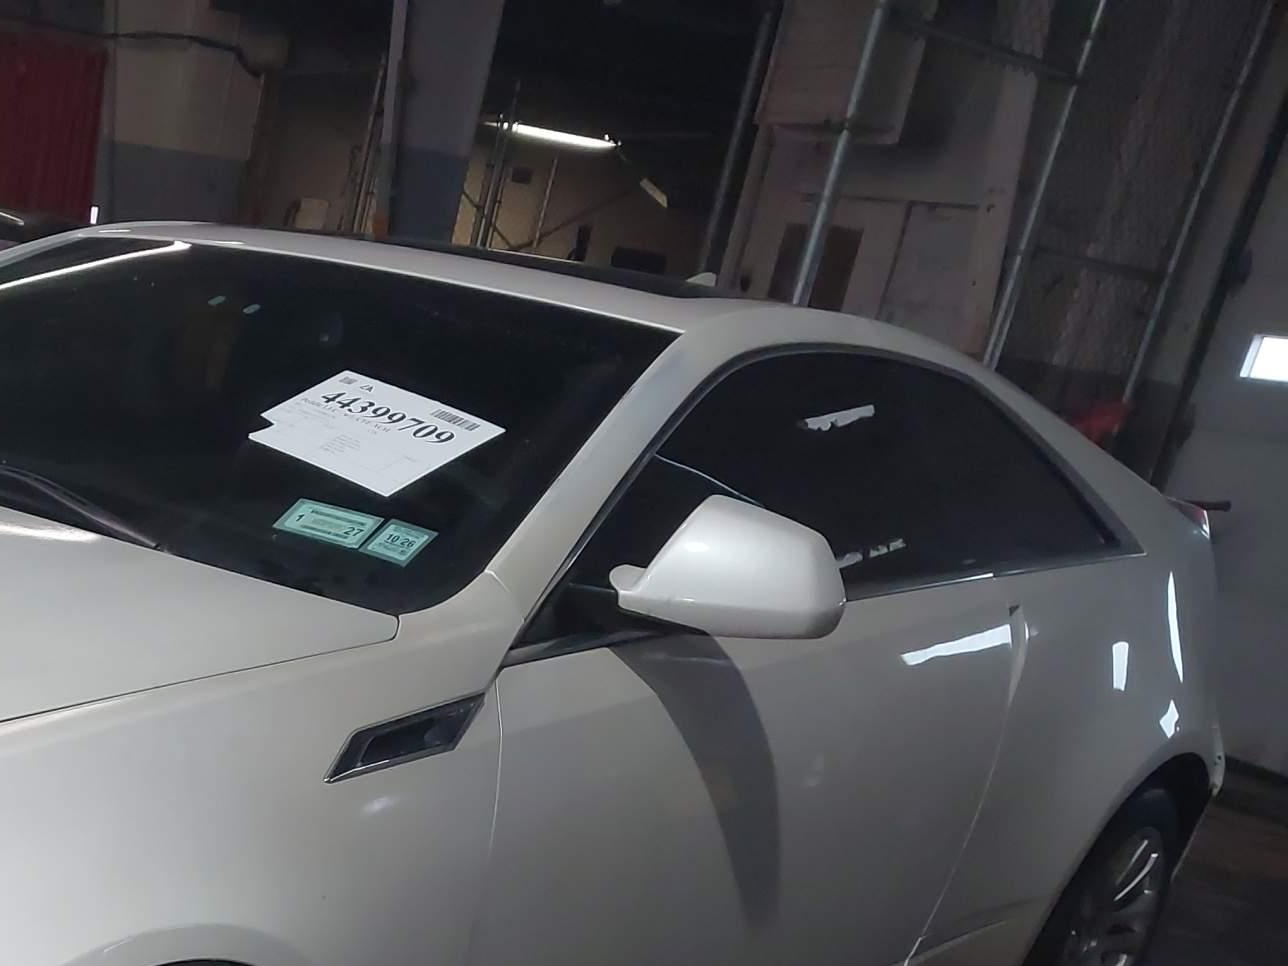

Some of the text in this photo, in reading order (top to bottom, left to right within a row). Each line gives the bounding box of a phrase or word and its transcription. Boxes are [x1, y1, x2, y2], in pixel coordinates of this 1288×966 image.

[320, 391, 456, 444] 44399709
[296, 513, 304, 521] 1
[343, 526, 365, 538] 27
[386, 532, 399, 544] 10
